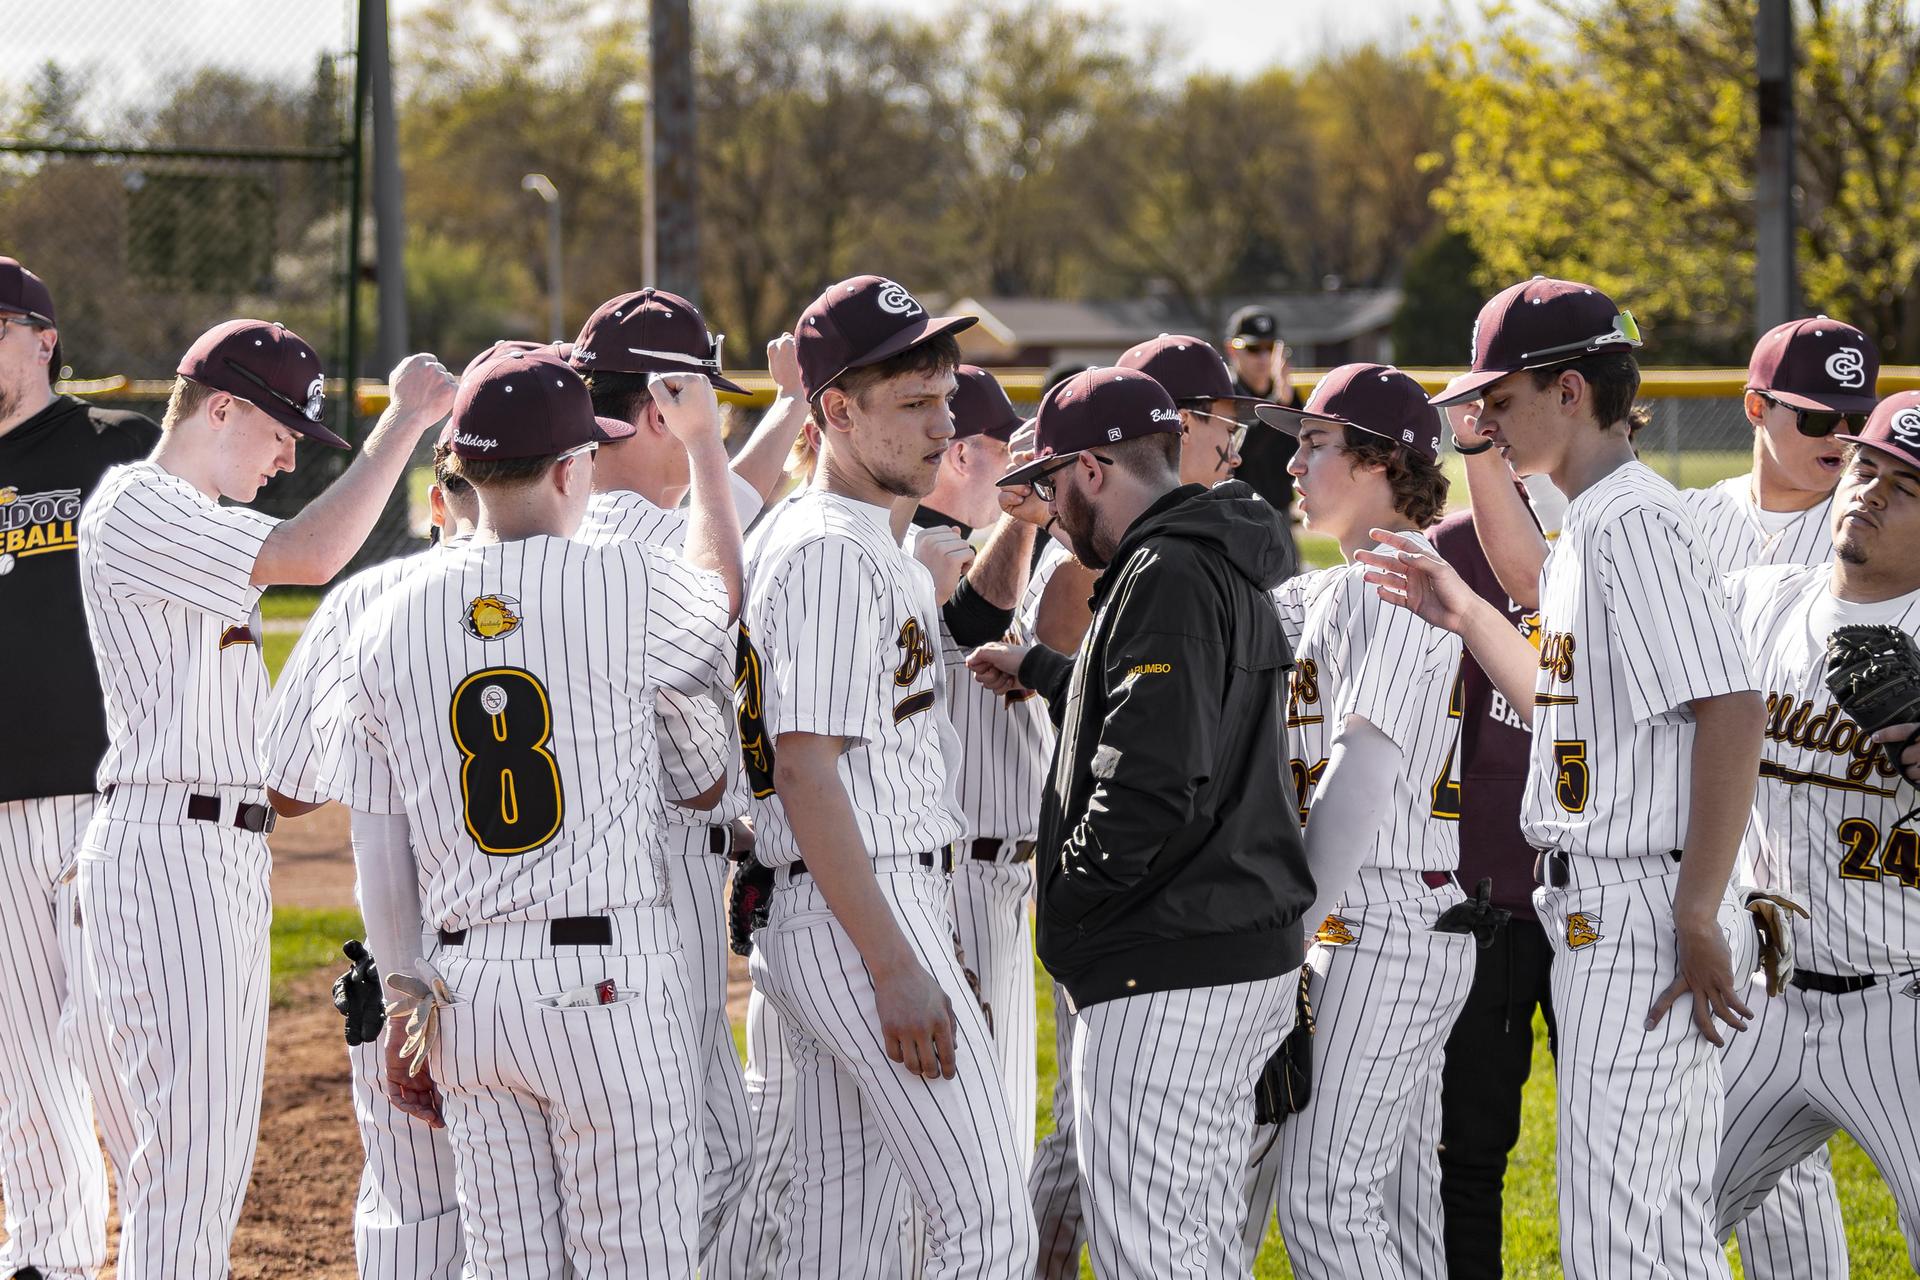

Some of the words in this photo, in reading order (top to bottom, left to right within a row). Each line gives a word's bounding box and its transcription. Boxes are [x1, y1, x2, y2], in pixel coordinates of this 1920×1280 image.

[453, 428, 498, 452] Bulldogs
[449, 666, 565, 857] 8
[1553, 739, 1590, 814] 5
[1837, 817, 1920, 888] 24
